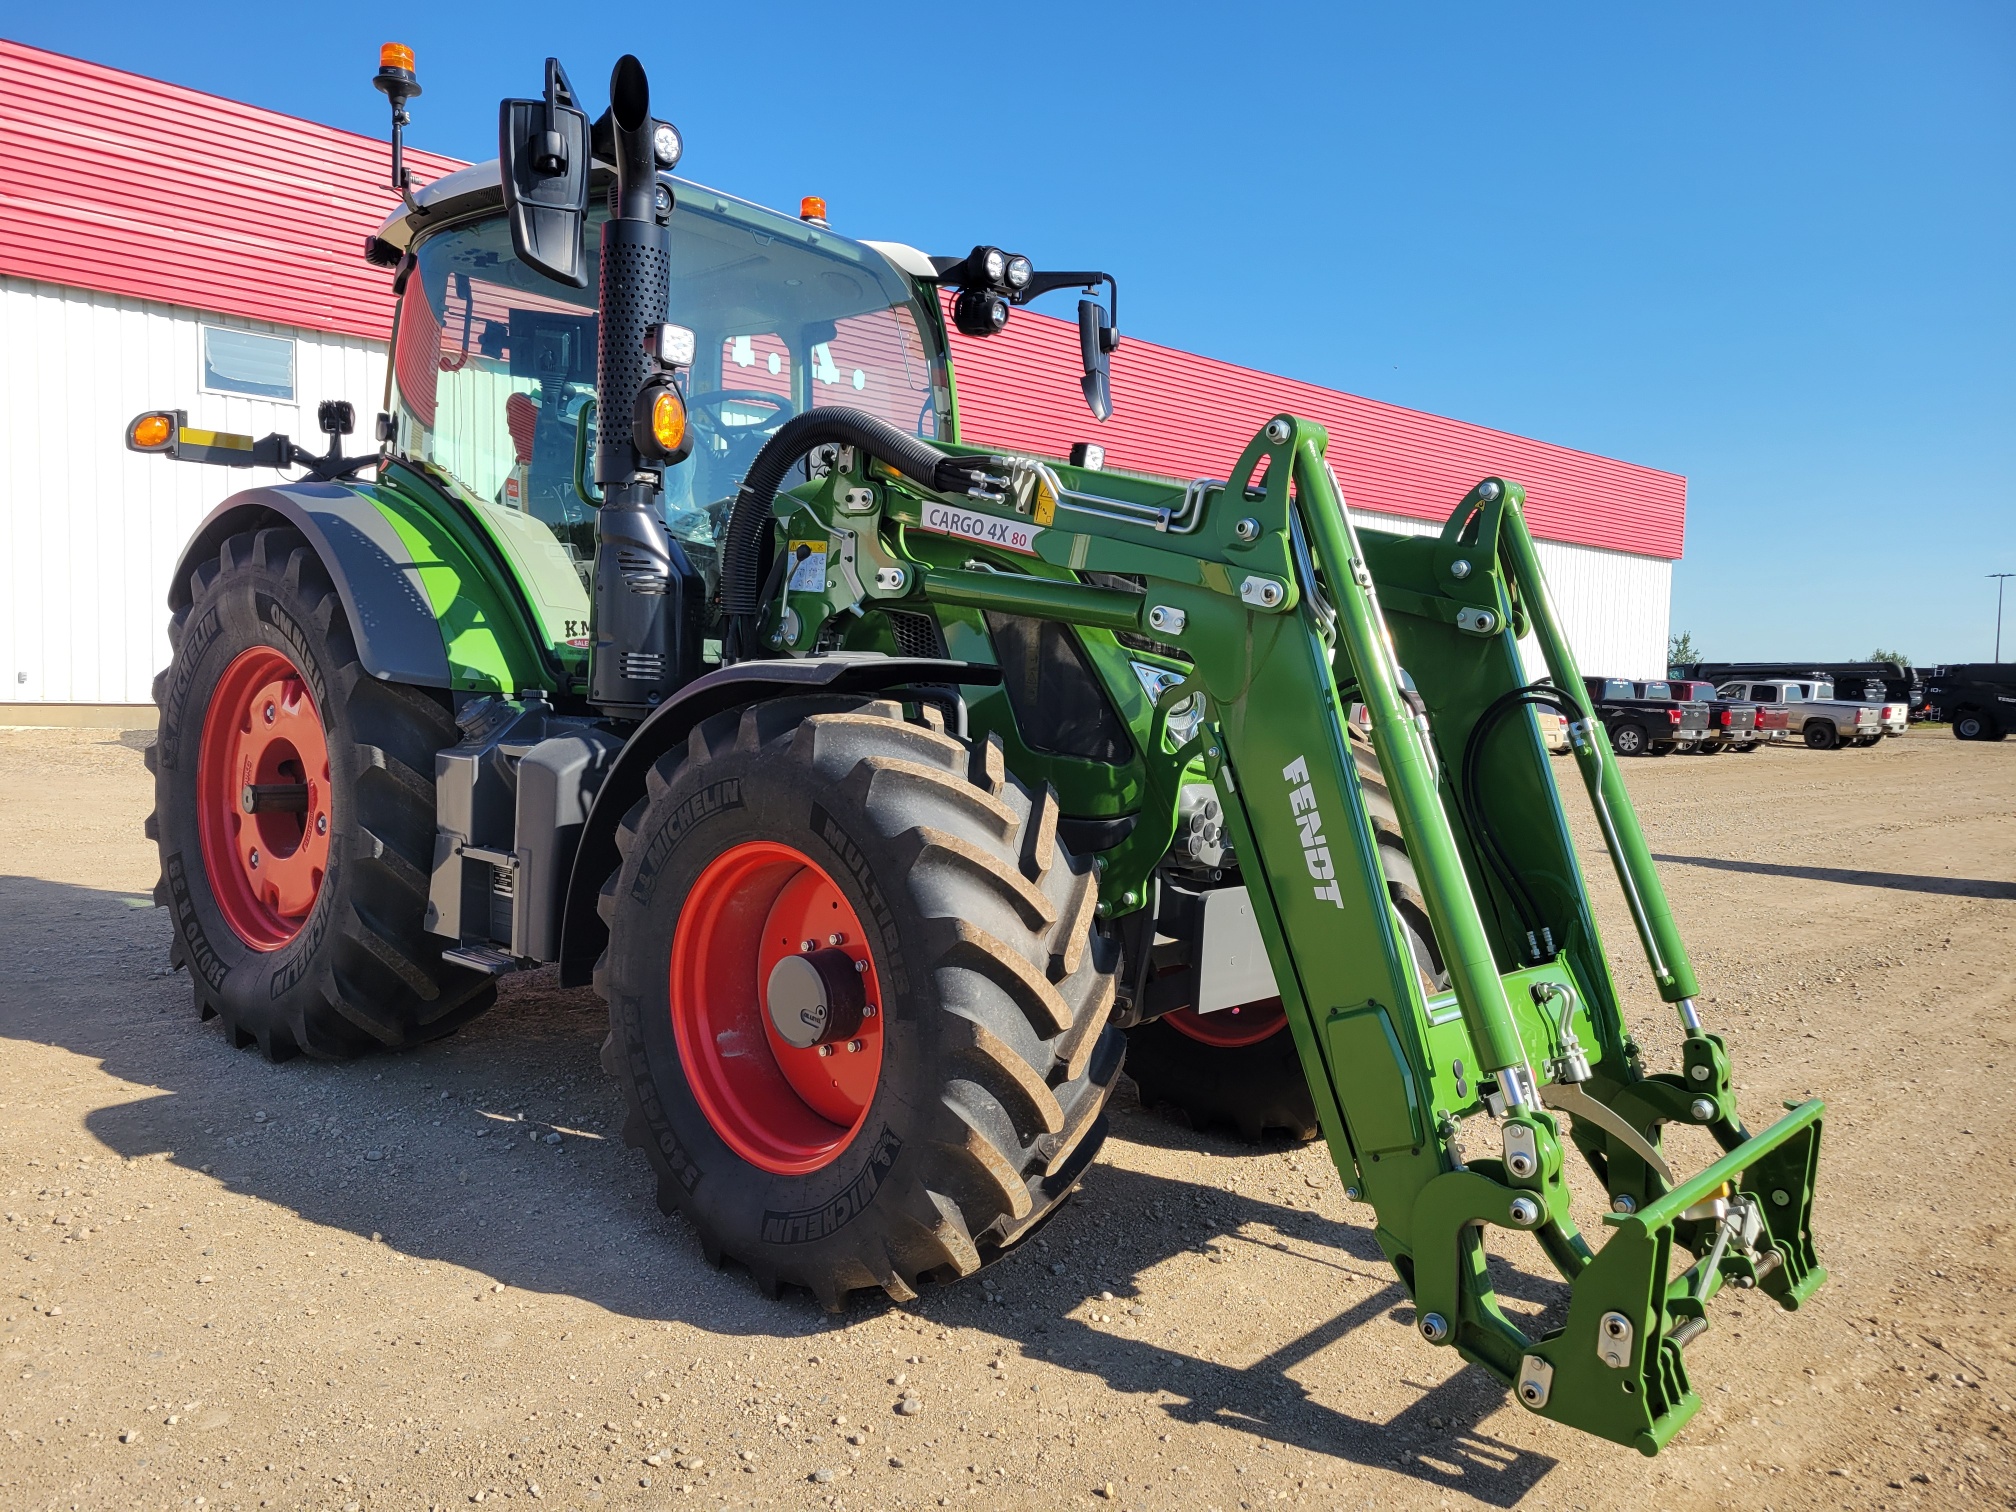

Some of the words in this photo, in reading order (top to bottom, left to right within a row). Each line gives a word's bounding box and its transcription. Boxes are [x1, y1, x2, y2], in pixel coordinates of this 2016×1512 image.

[929, 509, 984, 536] CARGO
[987, 523, 1009, 542] 4X
[1011, 532, 1027, 546] 80
[168, 606, 218, 725] MICHELIN
[271, 603, 327, 700] OMNIBIB
[650, 779, 741, 871] MICHELIN
[1283, 755, 1344, 909] FENDT
[169, 860, 184, 895] 38
[179, 898, 192, 921] R
[824, 817, 911, 996] MULTIBIB
[186, 921, 226, 988] 580/70
[274, 876, 335, 998] MICHELIN
[763, 1165, 880, 1243] MICHELIN
